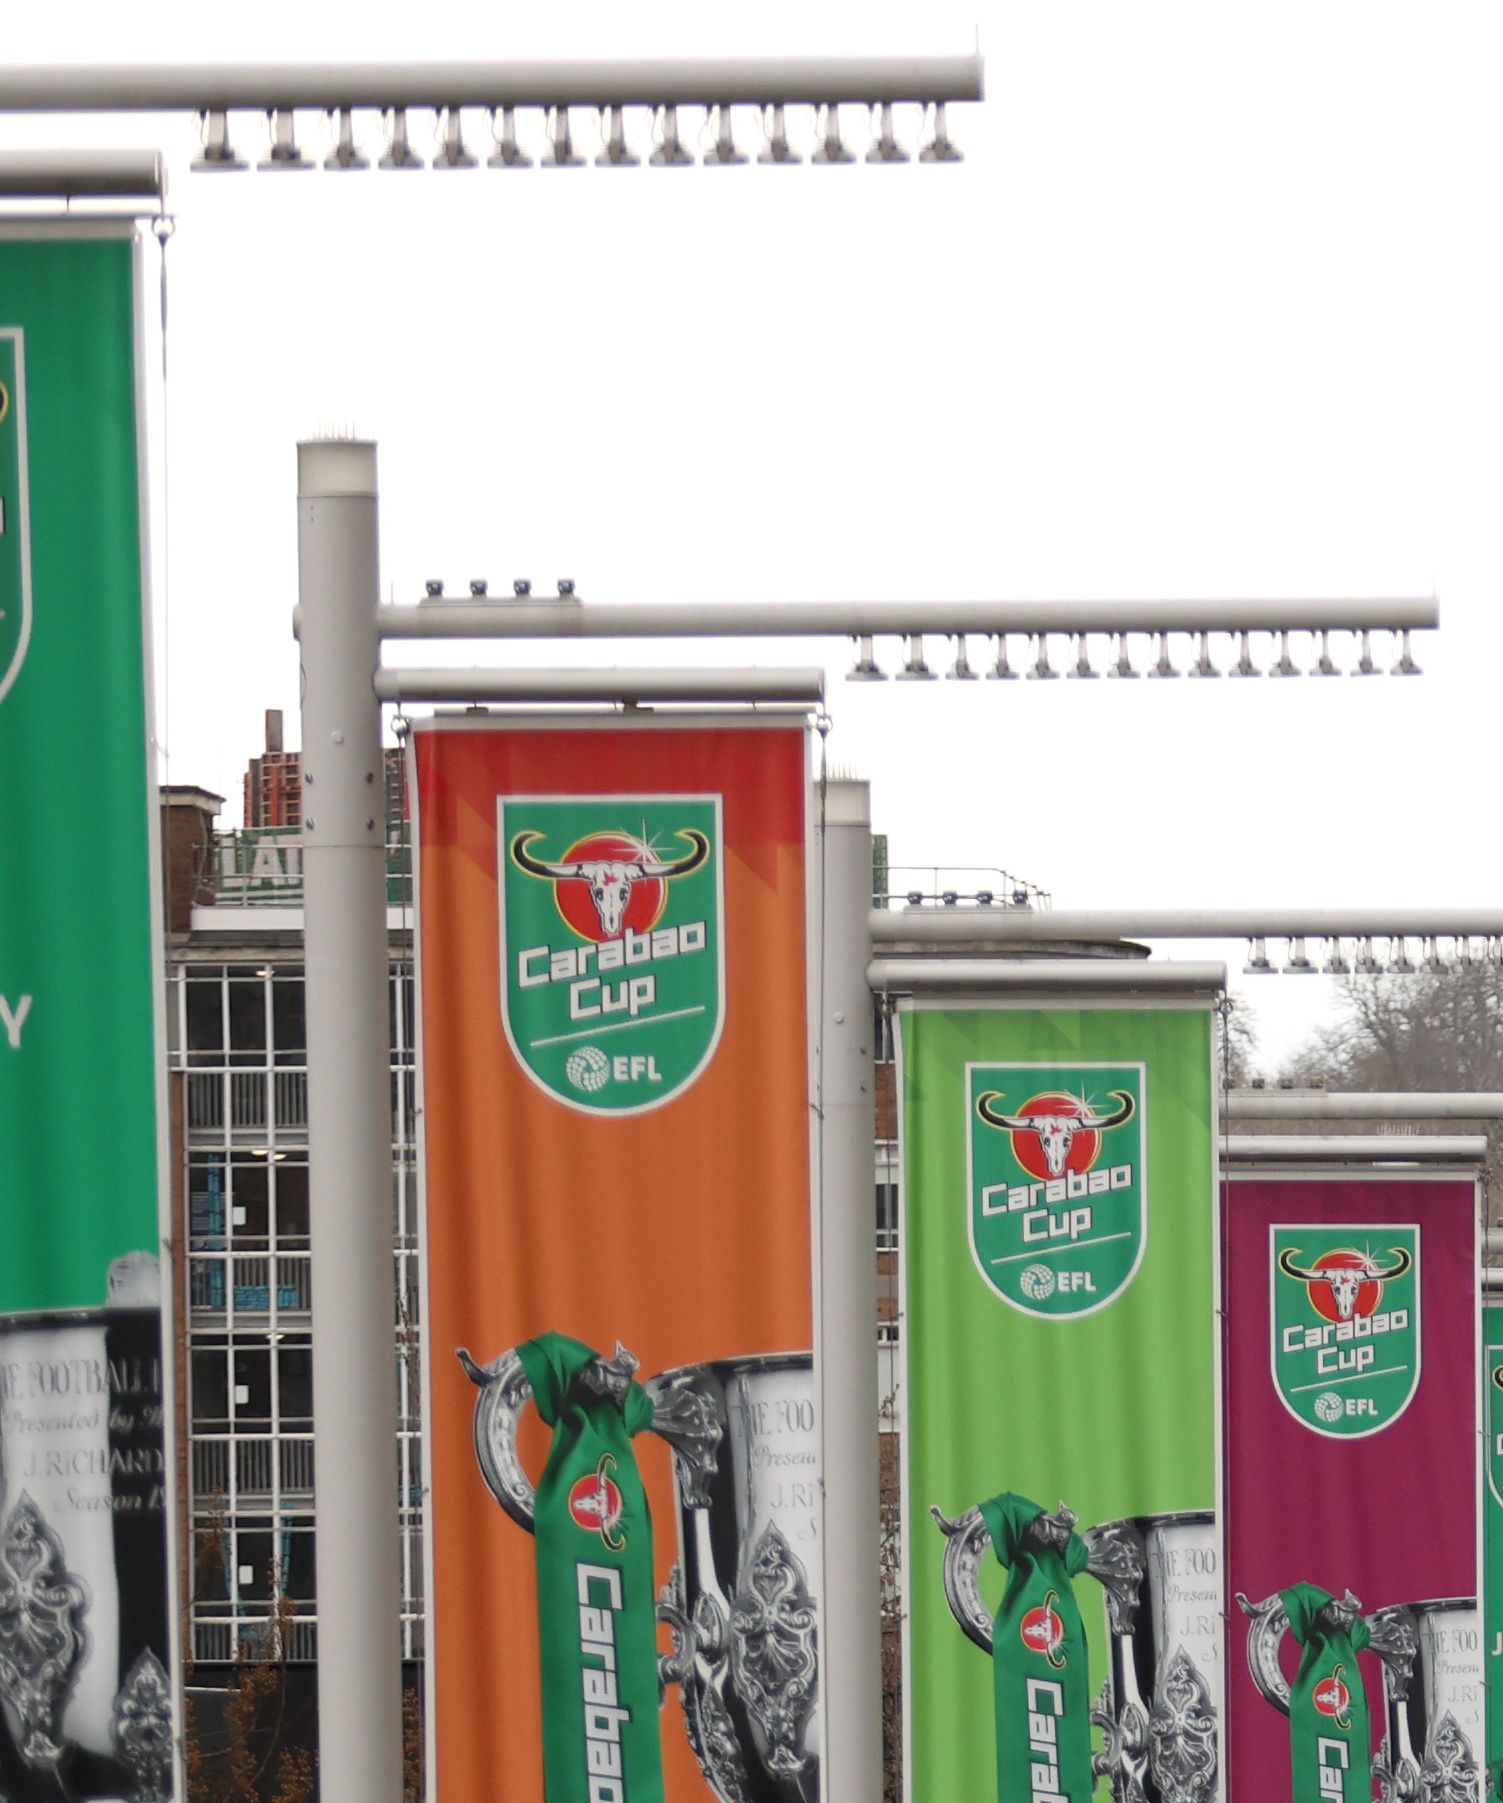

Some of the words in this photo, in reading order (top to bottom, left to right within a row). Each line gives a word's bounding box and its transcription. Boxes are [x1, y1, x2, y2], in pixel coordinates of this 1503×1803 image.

[517, 919, 706, 989] Carabao
[568, 972, 656, 1020] Cup
[613, 1055, 663, 1084] EFL
[981, 1162, 1132, 1219] Carabao
[1021, 1206, 1092, 1244] Cup
[1057, 1272, 1096, 1294] EFL
[1282, 1308, 1408, 1354] Carabao
[1317, 1344, 1374, 1375] Cup
[1345, 1399, 1378, 1416] EFL
